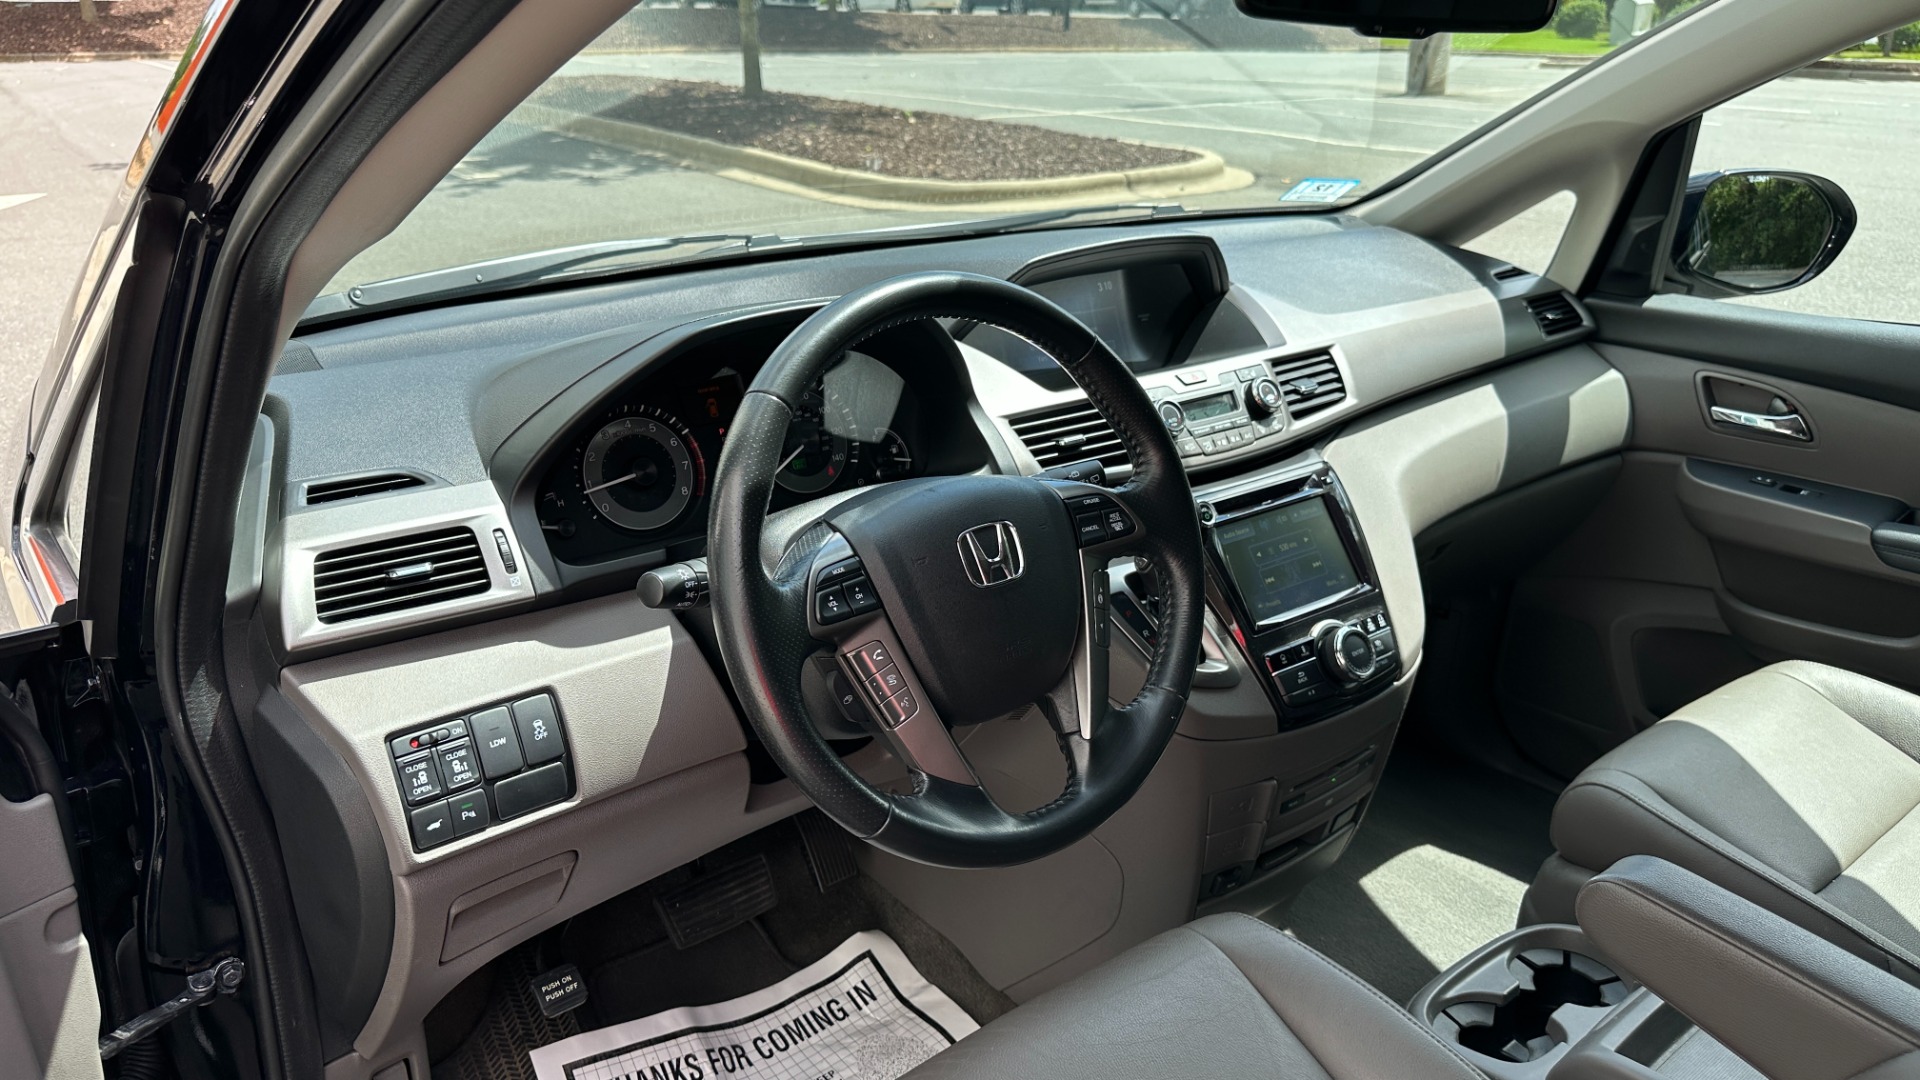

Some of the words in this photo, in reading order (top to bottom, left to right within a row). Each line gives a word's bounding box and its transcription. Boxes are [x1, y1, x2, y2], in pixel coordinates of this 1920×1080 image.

[649, 423, 657, 432] 5
[670, 437, 678, 446] 6
[588, 452, 596, 461] 2
[831, 453, 845, 461] 140
[681, 461, 689, 470] 7
[681, 486, 689, 495] 8
[602, 504, 609, 512] 0
[1081, 525, 1100, 533] CANCEL
[831, 567, 846, 575] MODE
[827, 600, 839, 608] VOL
[452, 726, 463, 735] ON
[534, 731, 549, 741] OFF
[489, 737, 507, 748] LDW
[445, 749, 467, 761] CLOSE
[405, 761, 428, 773] CLOSE
[453, 771, 472, 782] OPEN
[413, 784, 432, 795] OPEN
[541, 980, 560, 993] PUSH
[561, 974, 572, 984] ON
[545, 989, 564, 1002] PUSH
[565, 982, 578, 993] OFF
[705, 1043, 753, 1075] FOR
[753, 998, 850, 1060] COMING
[846, 979, 878, 1011] IN
